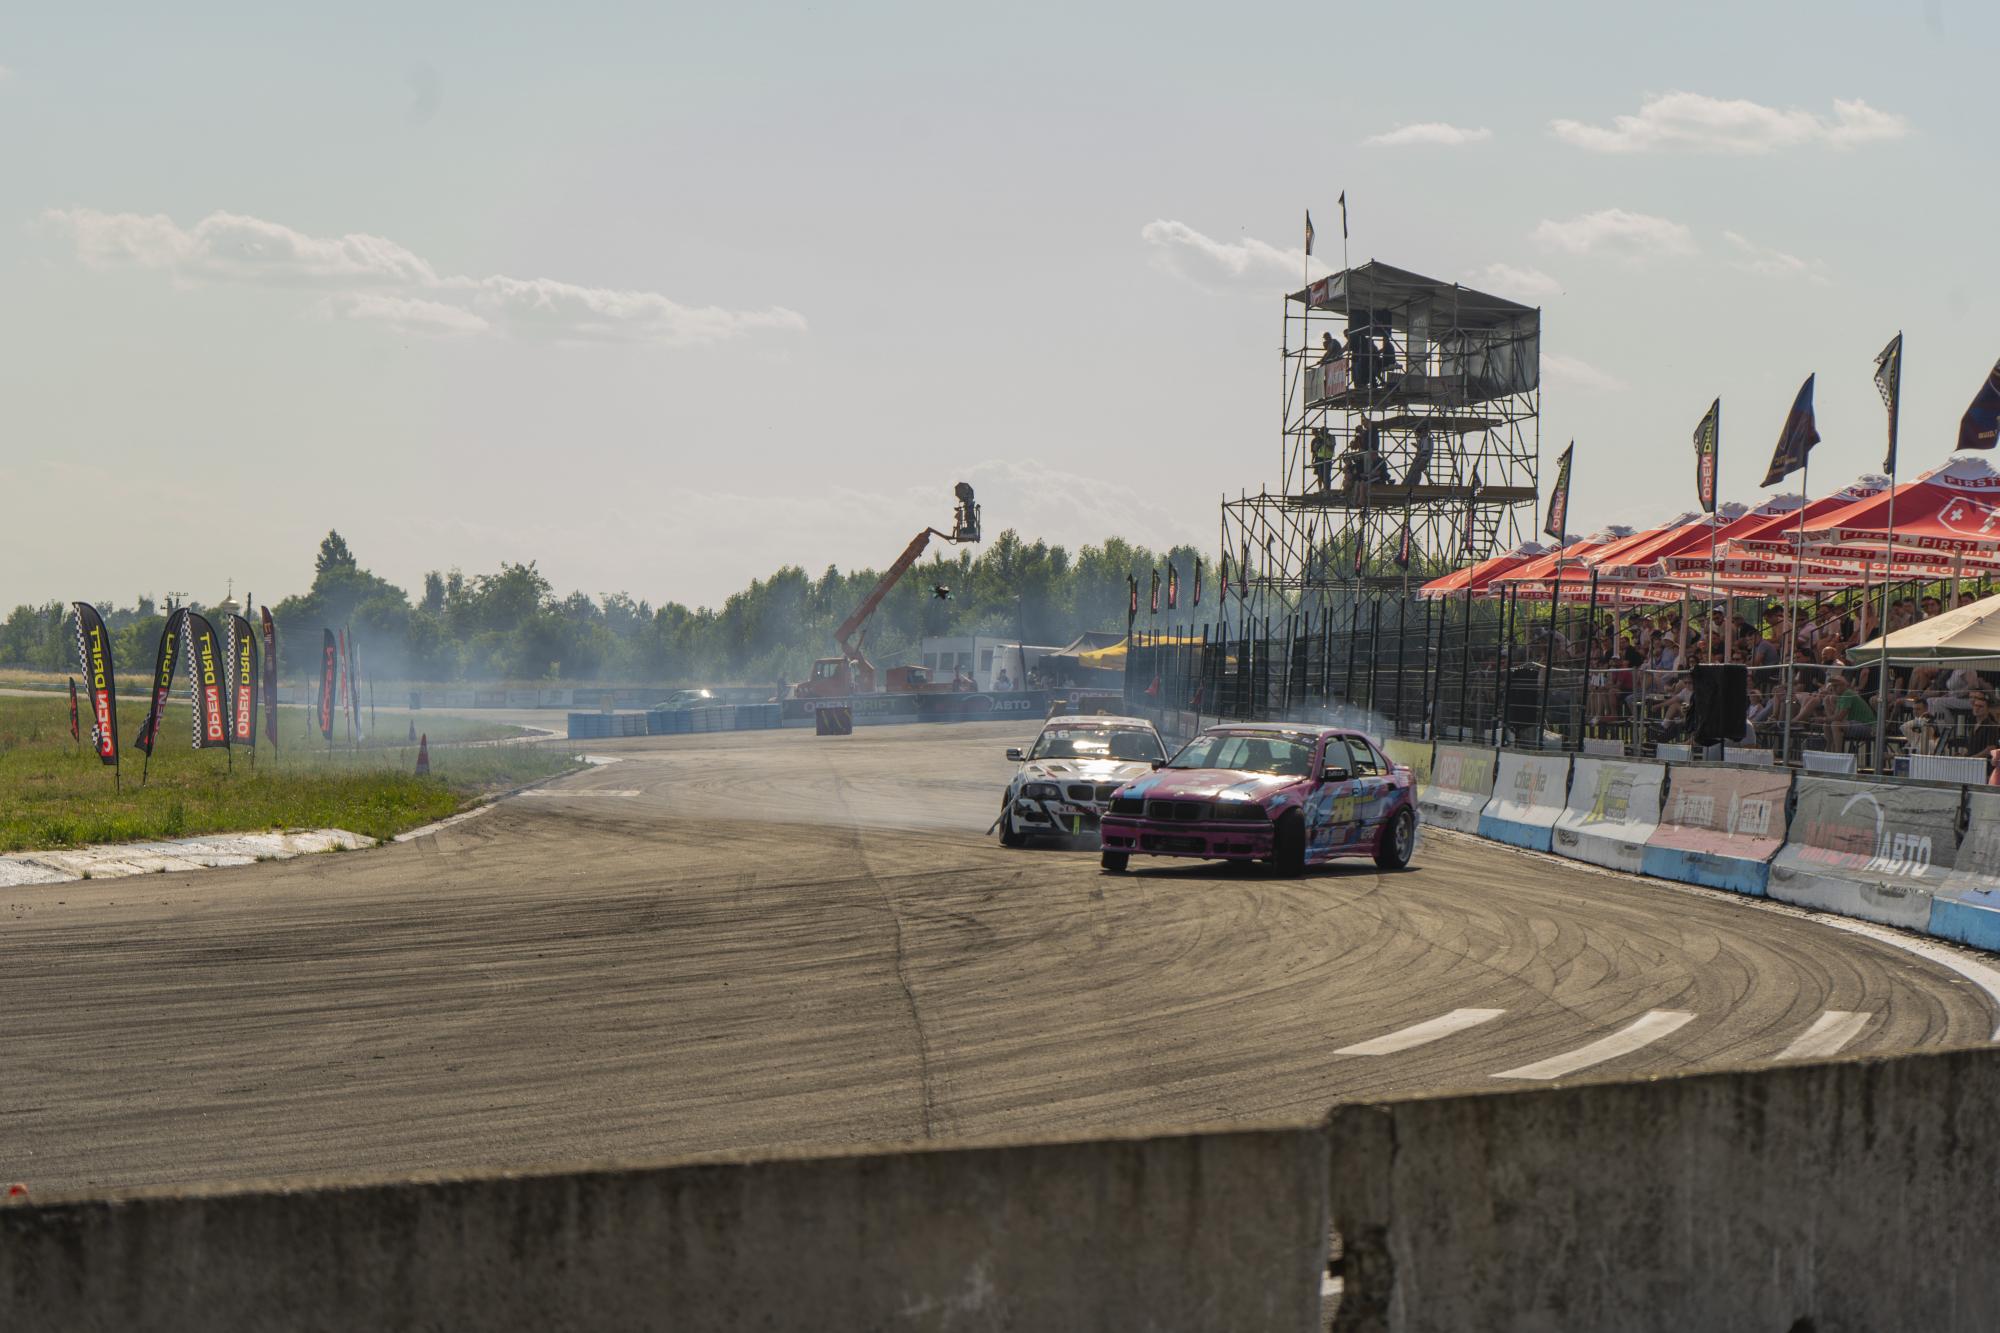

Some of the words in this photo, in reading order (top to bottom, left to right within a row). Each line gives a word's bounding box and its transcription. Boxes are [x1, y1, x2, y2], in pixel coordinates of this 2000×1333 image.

[1921, 538, 1975, 551] FIRST
[1823, 548, 1873, 558] FIRST
[1896, 553, 1946, 563] FIRST
[1744, 561, 1788, 571] FIRST
[853, 698, 897, 711] DRIFT
[1870, 831, 1932, 878] АВТО
